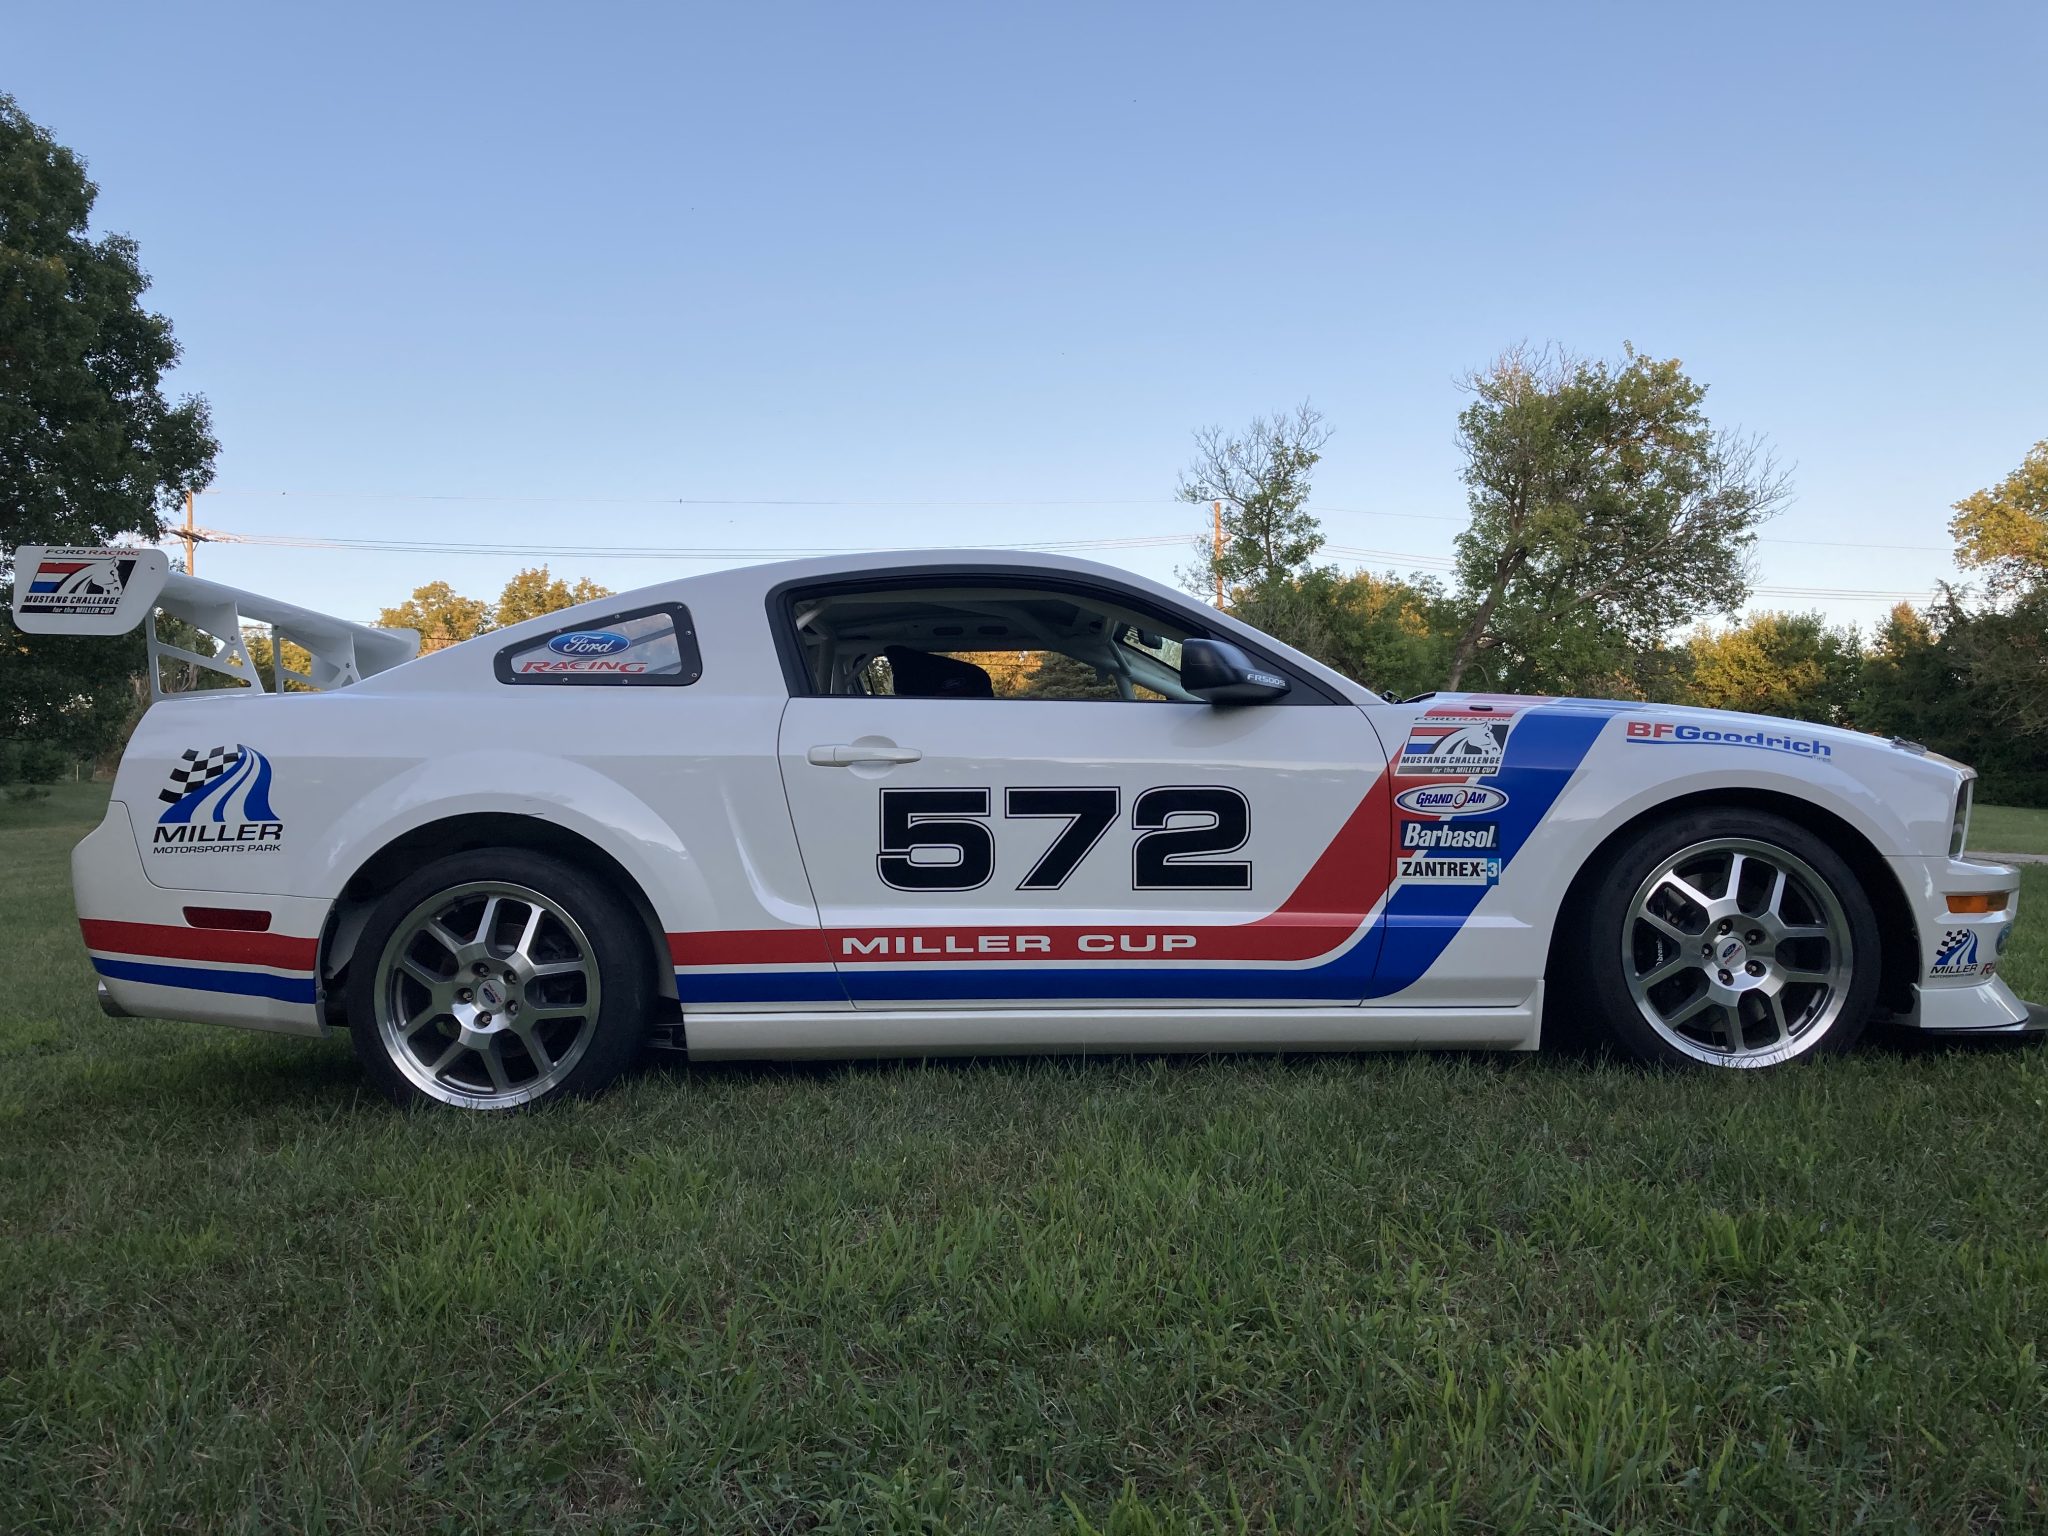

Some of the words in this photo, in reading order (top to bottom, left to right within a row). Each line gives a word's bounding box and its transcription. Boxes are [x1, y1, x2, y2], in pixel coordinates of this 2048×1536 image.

[24, 595, 69, 604] MUSTANG
[70, 596, 121, 605] CHALLENGE
[75, 606, 100, 614] MILLER
[563, 635, 616, 653] Ford
[521, 662, 648, 673] RACING
[1247, 673, 1286, 686] FR500S
[1626, 722, 1832, 756] BFGoodrich
[1401, 756, 1448, 764] MUSTANG
[1448, 756, 1501, 764] CHALLENGE
[1455, 766, 1481, 774] MILLER
[153, 824, 284, 843] MILLER
[876, 785, 1252, 892] 572
[1404, 822, 1496, 848] Barbasol
[153, 845, 245, 854] MOTORSPORTS
[247, 844, 282, 852] PARK
[842, 935, 1051, 955] MILLER
[1077, 934, 1197, 953] CUP
[1930, 964, 1978, 974] MILLER
